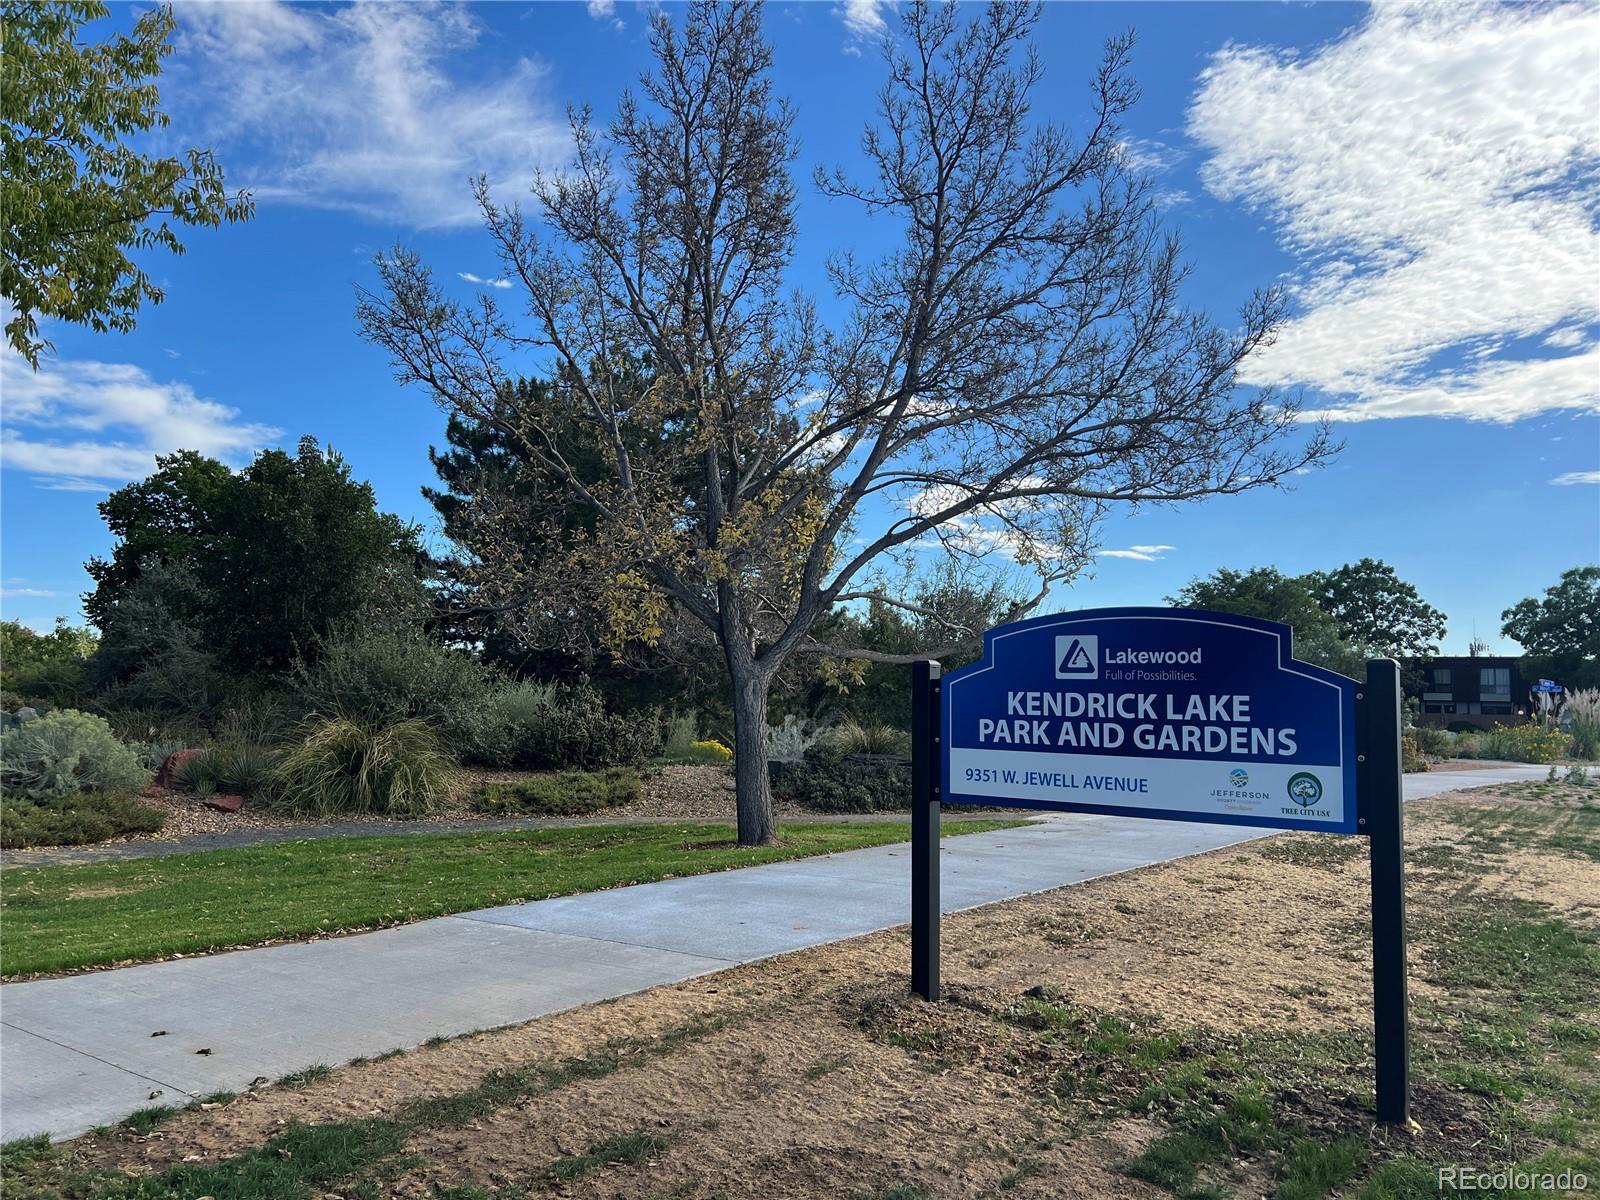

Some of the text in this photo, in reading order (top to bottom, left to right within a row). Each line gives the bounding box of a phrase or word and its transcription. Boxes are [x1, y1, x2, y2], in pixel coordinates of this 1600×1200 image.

[1105, 648, 1202, 664] Lakewood
[1105, 670, 1198, 681] Full of Possibilities.
[1007, 691, 1251, 722] KENDRICK LAKE
[979, 718, 1298, 757] PARK AND GARDENS
[965, 768, 1148, 793] 9351 W. JEWELL AVENUE
[1210, 789, 1270, 800] JEFFERSON
[1281, 807, 1299, 815] TREE
[1300, 808, 1316, 816] CITY
